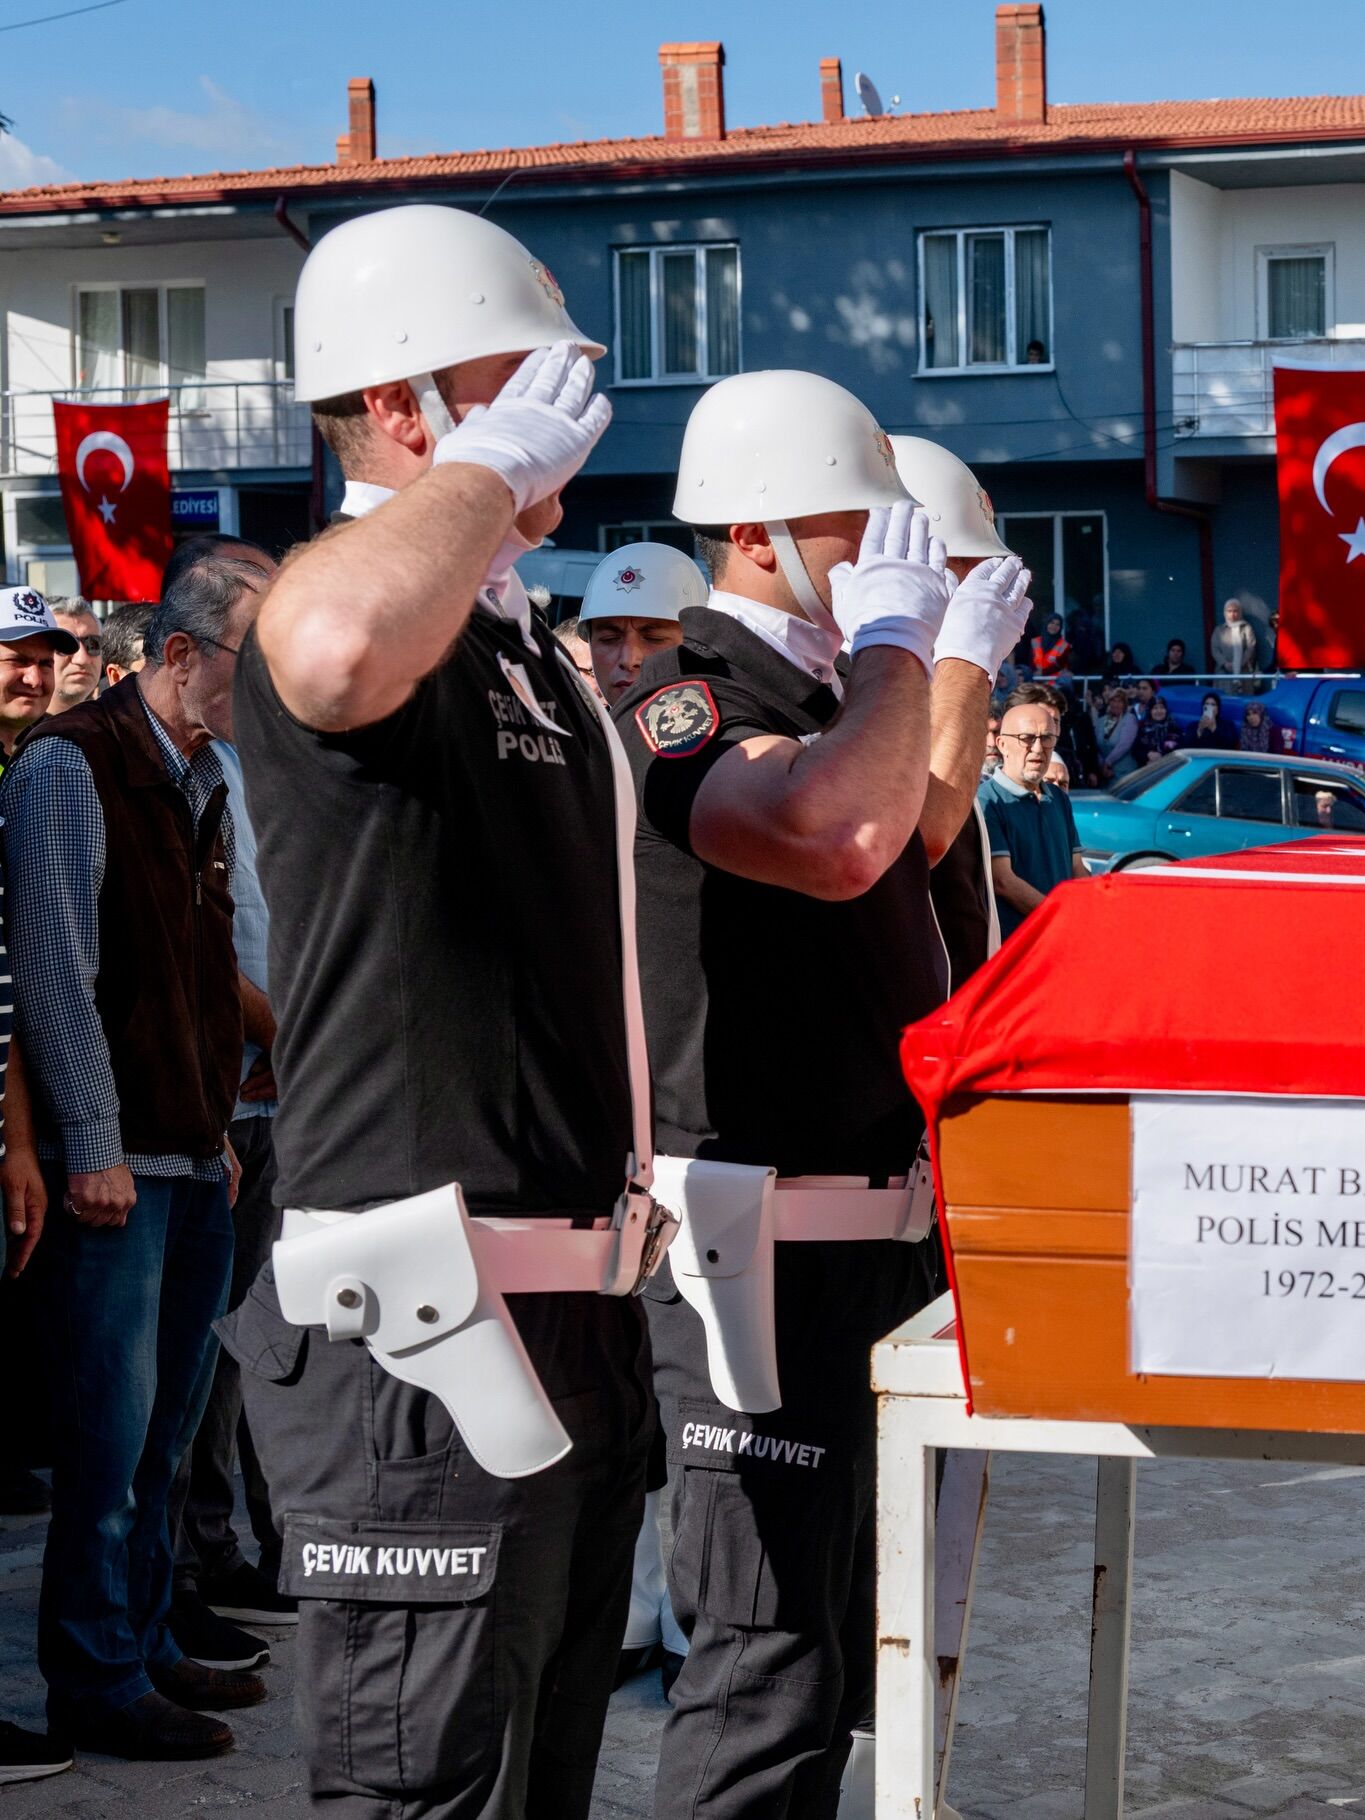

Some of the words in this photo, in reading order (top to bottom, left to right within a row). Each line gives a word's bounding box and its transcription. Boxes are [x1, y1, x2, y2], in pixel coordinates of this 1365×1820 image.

[171, 496, 218, 514] EDİYESİ
[1183, 1162, 1327, 1196] MURAT
[1196, 1212, 1304, 1247] POLİS
[737, 1431, 826, 1469] KUVVET
[376, 1547, 487, 1576] KUVVET
